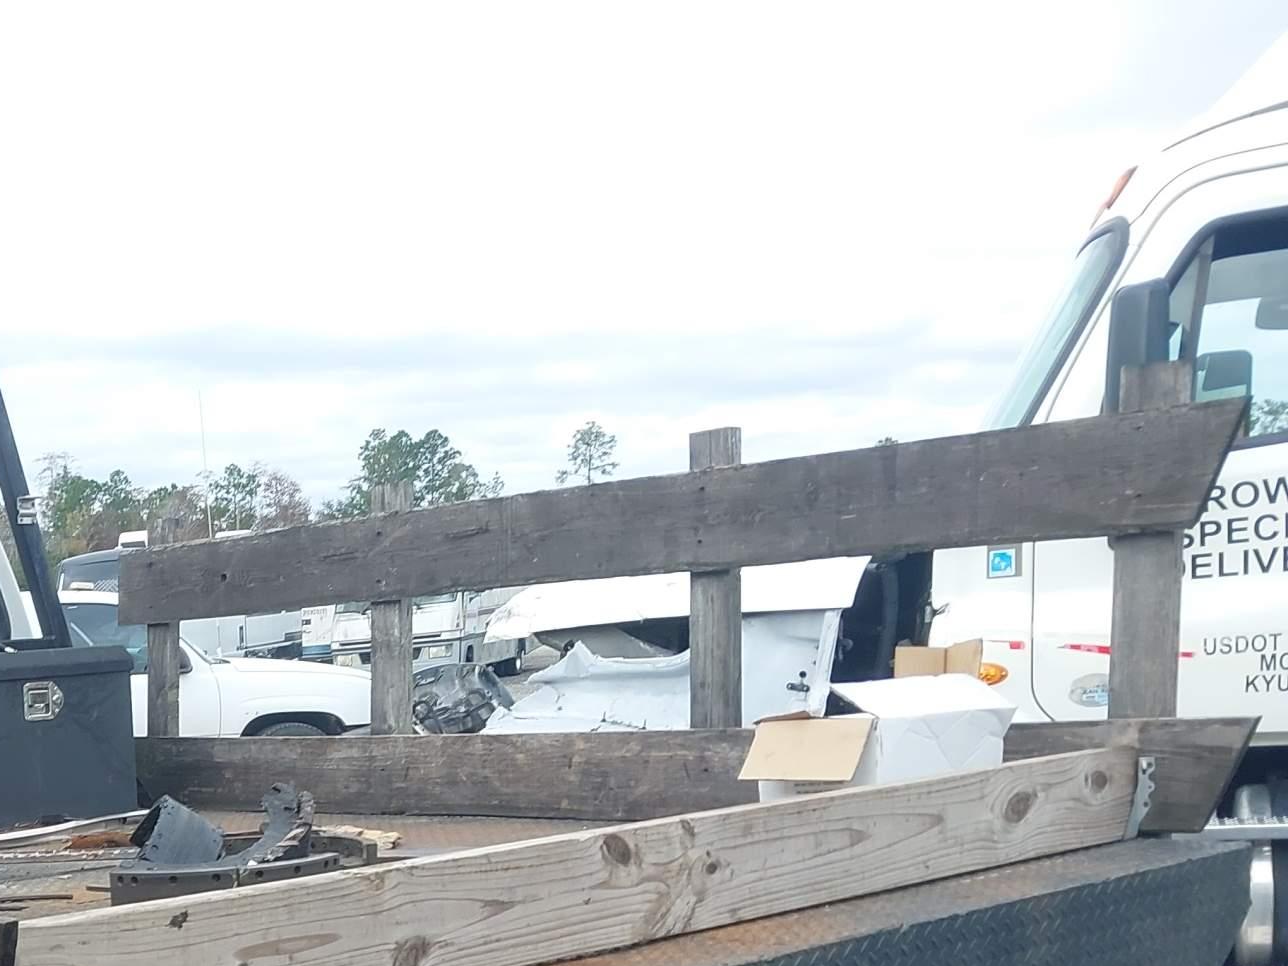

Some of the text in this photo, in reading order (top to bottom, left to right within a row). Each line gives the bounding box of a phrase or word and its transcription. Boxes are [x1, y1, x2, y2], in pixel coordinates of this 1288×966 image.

[1182, 546, 1288, 580] ELIV
[1203, 633, 1283, 656] USDOT
[1245, 674, 1288, 693] KYU
